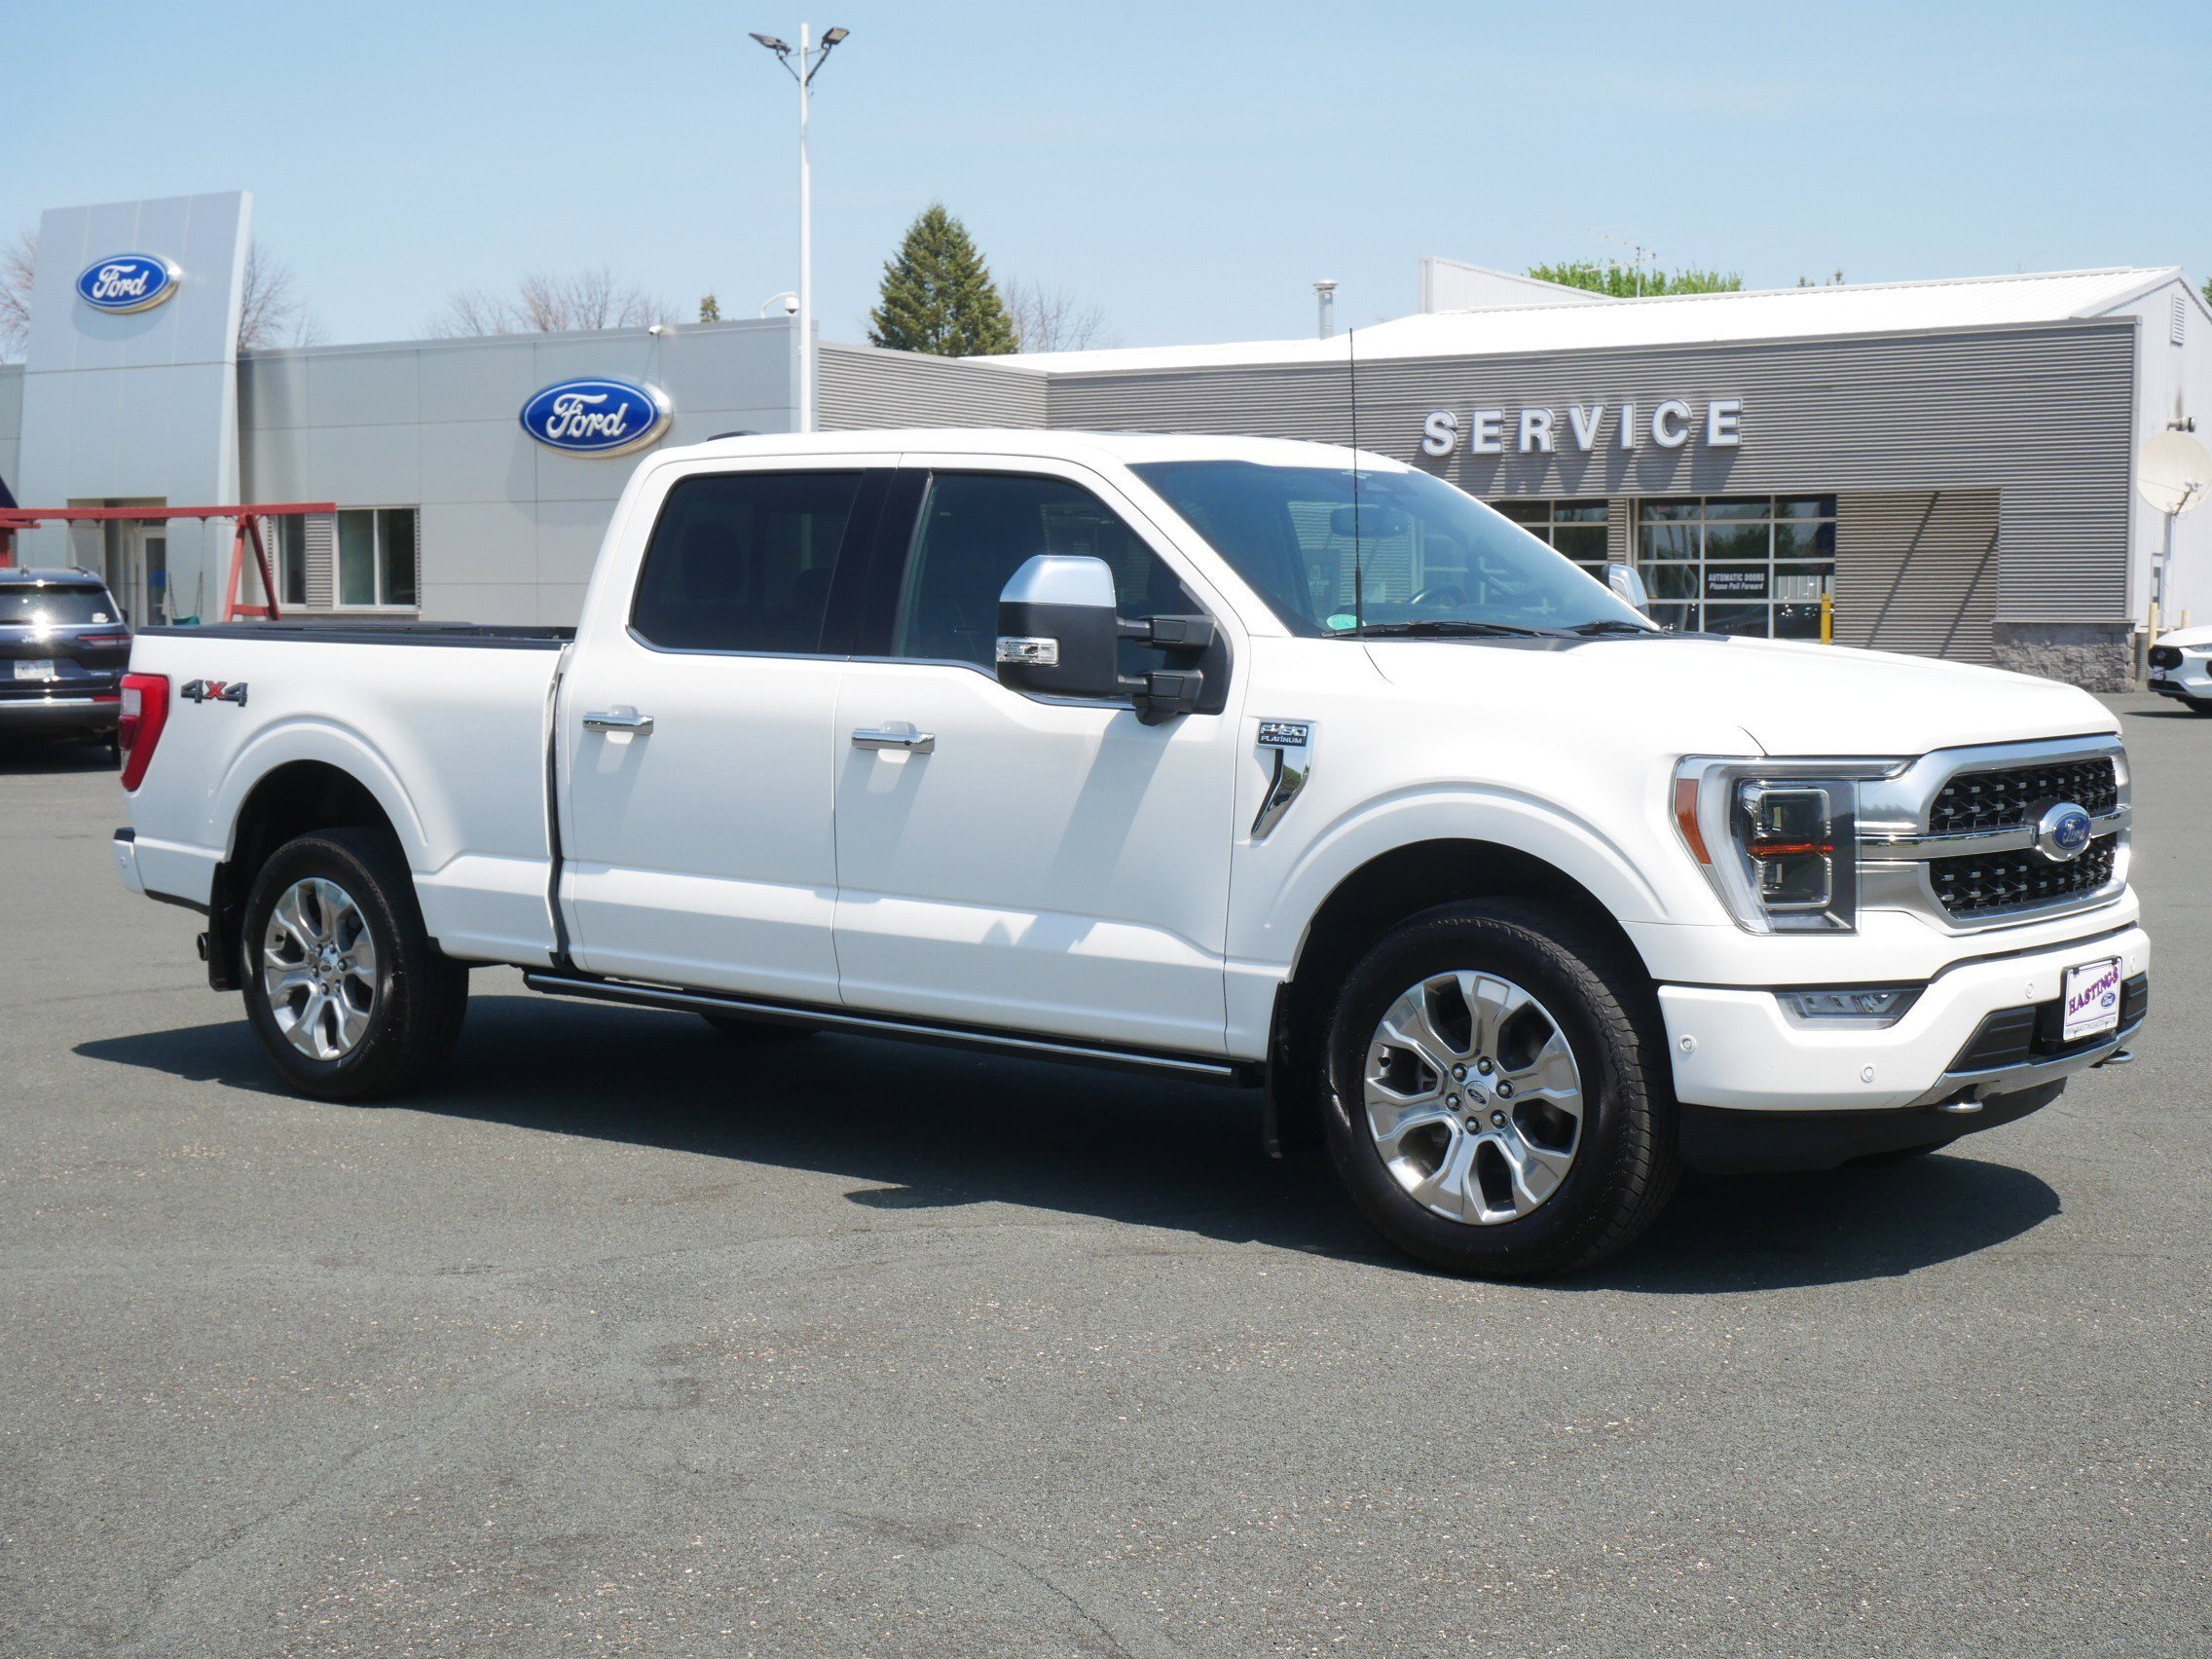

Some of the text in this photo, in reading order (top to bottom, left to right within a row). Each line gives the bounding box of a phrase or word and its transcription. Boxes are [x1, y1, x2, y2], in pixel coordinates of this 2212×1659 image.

[92, 264, 150, 299] Ford
[546, 393, 629, 438] Ford
[1421, 398, 1744, 457] SERVICE
[1708, 572, 1765, 581] AUTOMATIC DOORS
[1261, 735, 1303, 744] PLATINUM
[2062, 819, 2085, 844] Ford
[2069, 967, 2119, 1016] HASTINGS
